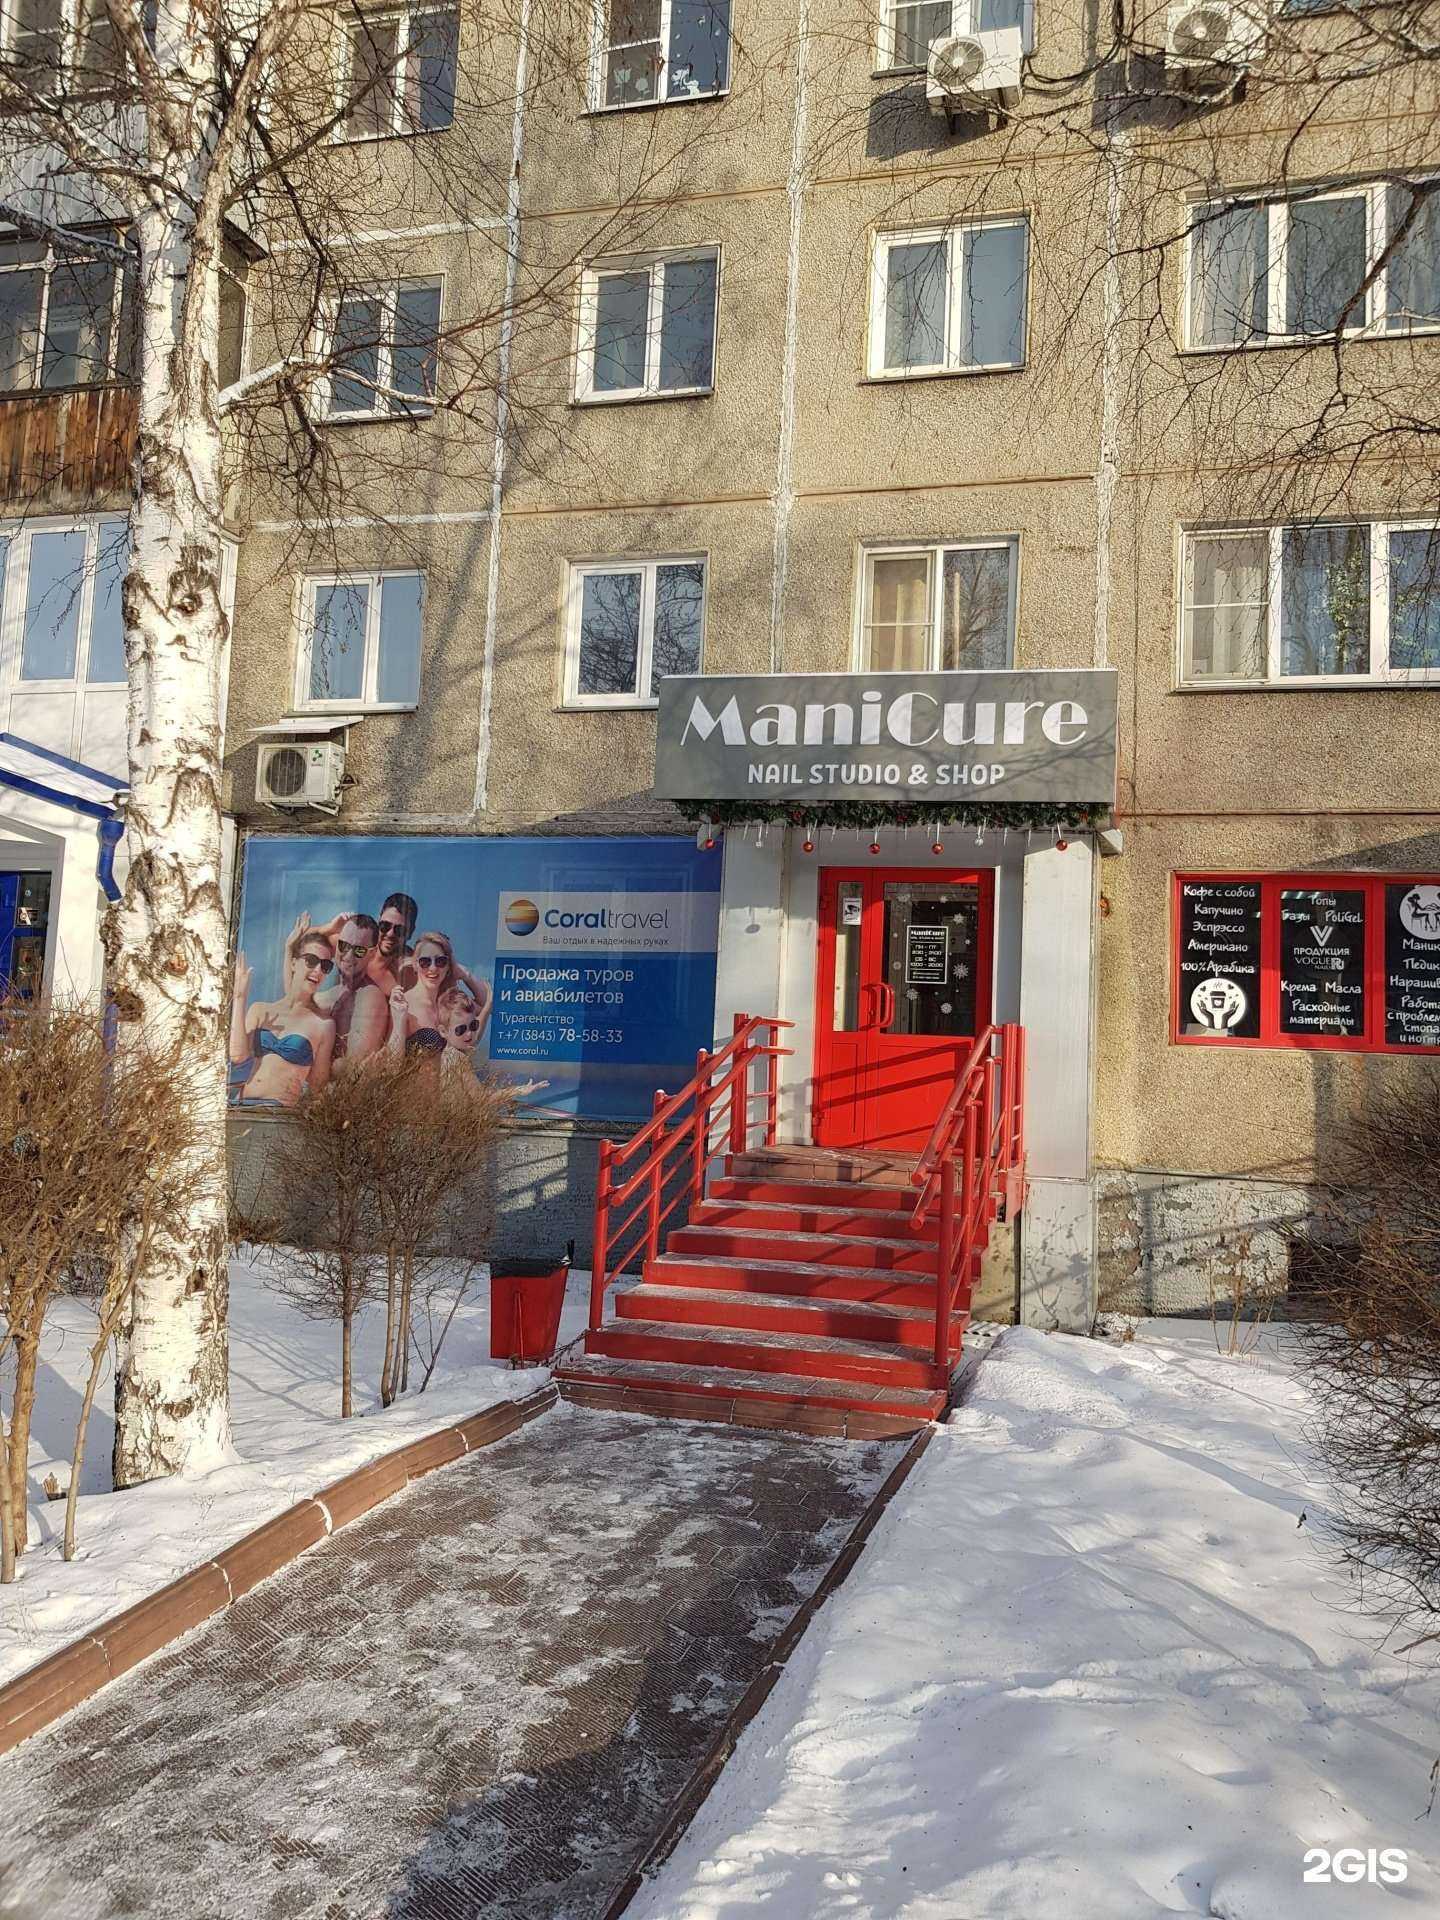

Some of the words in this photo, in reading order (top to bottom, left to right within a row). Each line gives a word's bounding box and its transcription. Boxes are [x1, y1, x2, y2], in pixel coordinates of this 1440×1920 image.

[680, 691, 1088, 746] ManiCure
[748, 764, 803, 784] NAIL
[808, 764, 901, 784] STUDIO
[907, 764, 928, 784] &
[935, 764, 1005, 785] SHOP
[1184, 885, 1214, 901] Кофе
[1216, 889, 1223, 897] с
[1225, 886, 1256, 897] собой
[1308, 894, 1337, 906] Топы
[1194, 904, 1244, 919] Капучино
[1281, 909, 1311, 923] Базы
[1193, 920, 1245, 937] Эспрэссо
[543, 935, 560, 945] Ваш
[562, 936, 588, 947] отдых
[597, 937, 641, 947] надежных
[643, 938, 670, 948] руках
[1188, 938, 1249, 956] Американо
[1293, 947, 1350, 956] ПРОДУКЦИЯ
[502, 964, 580, 983] Продажа
[584, 969, 634, 985] туров
[501, 990, 511, 1001] и
[515, 987, 624, 1004] авиабилетов
[1281, 980, 1317, 997] Крема
[1325, 981, 1362, 994] Масла
[1292, 998, 1352, 1012] Расходные
[498, 1012, 574, 1026] Турагентство
[1289, 1016, 1355, 1031] материалы
[558, 1028, 624, 1043] 78-58-33
